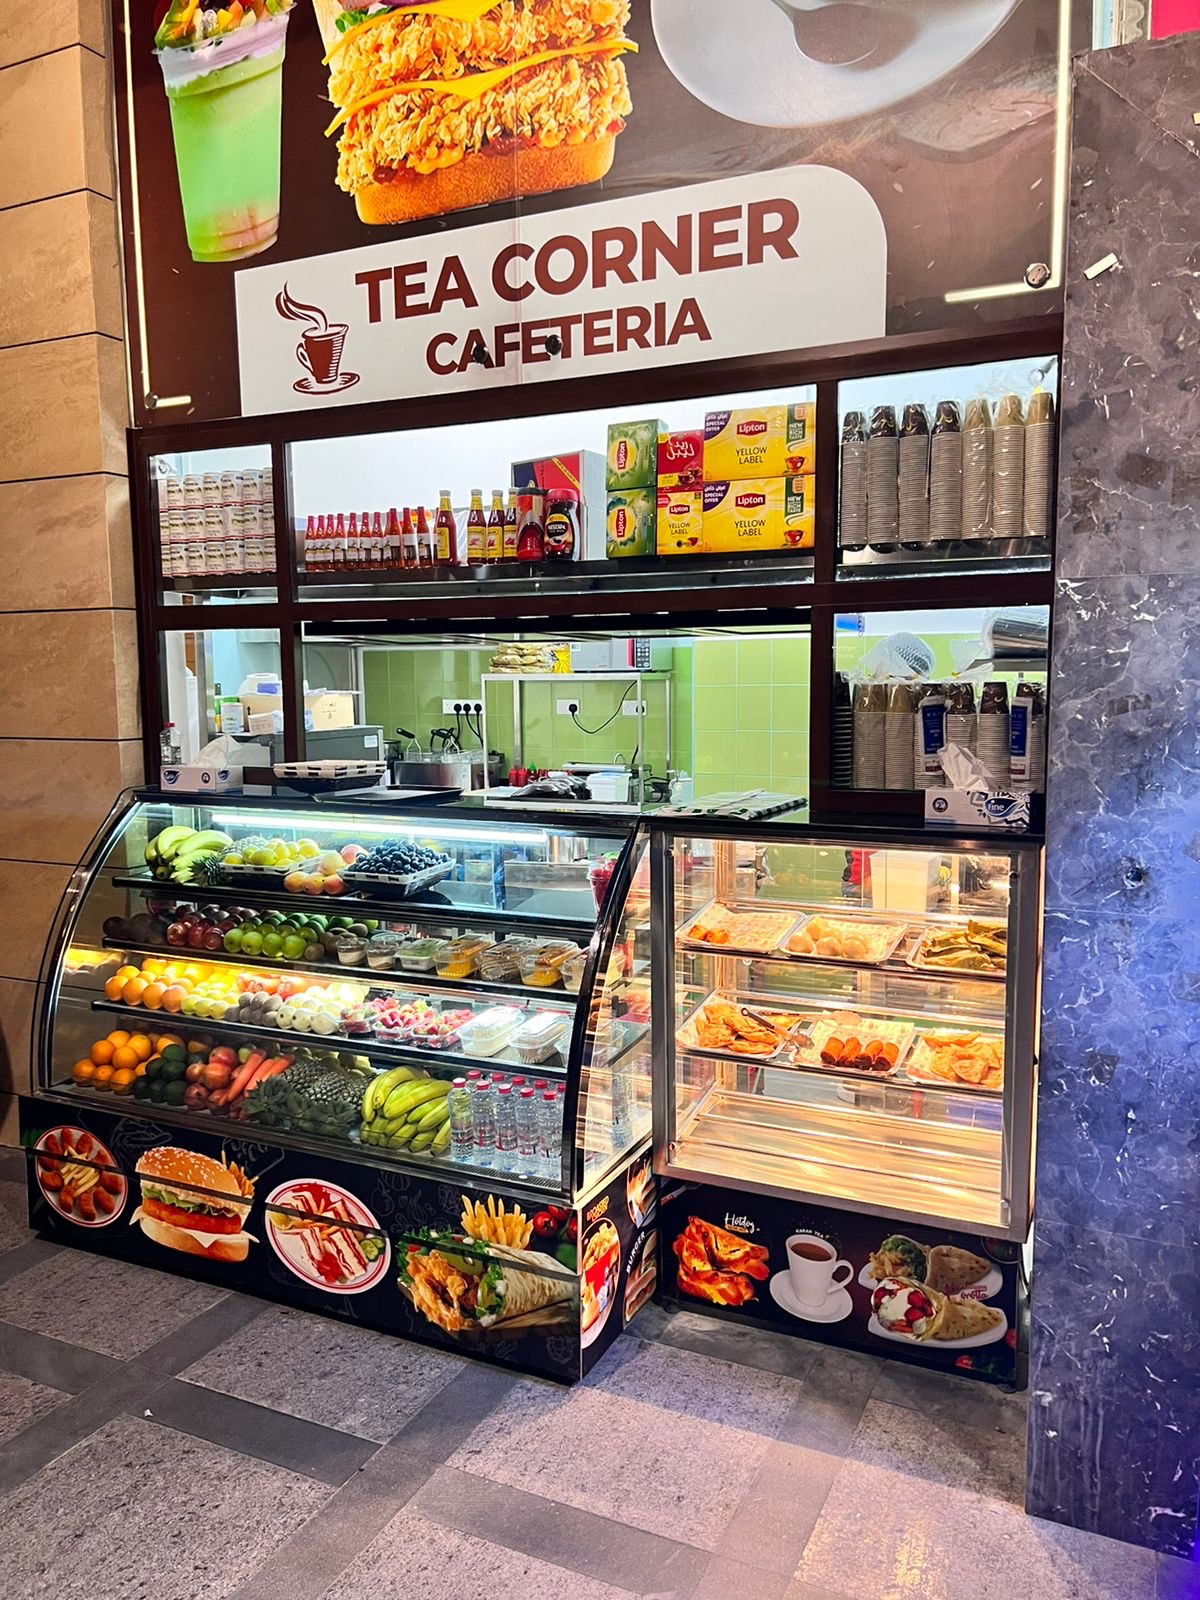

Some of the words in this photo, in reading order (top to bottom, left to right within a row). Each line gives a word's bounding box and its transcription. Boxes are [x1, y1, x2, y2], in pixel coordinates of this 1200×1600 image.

[355, 255, 479, 323] TEA
[491, 198, 800, 302] CORNER
[425, 297, 713, 376] CAFETERIA
[739, 423, 765, 434] Lipton
[618, 442, 626, 468] Lipton
[736, 446, 767, 457] YELLOW
[739, 456, 763, 465] LABEL
[737, 495, 764, 506] Lipton
[670, 505, 689, 513] Lipton
[617, 511, 625, 536] Lipton
[734, 519, 766, 529] YELLOW
[738, 528, 762, 537] LABEL
[724, 1212, 755, 1234] Hotdog
[626, 1231, 645, 1274] BURGER
